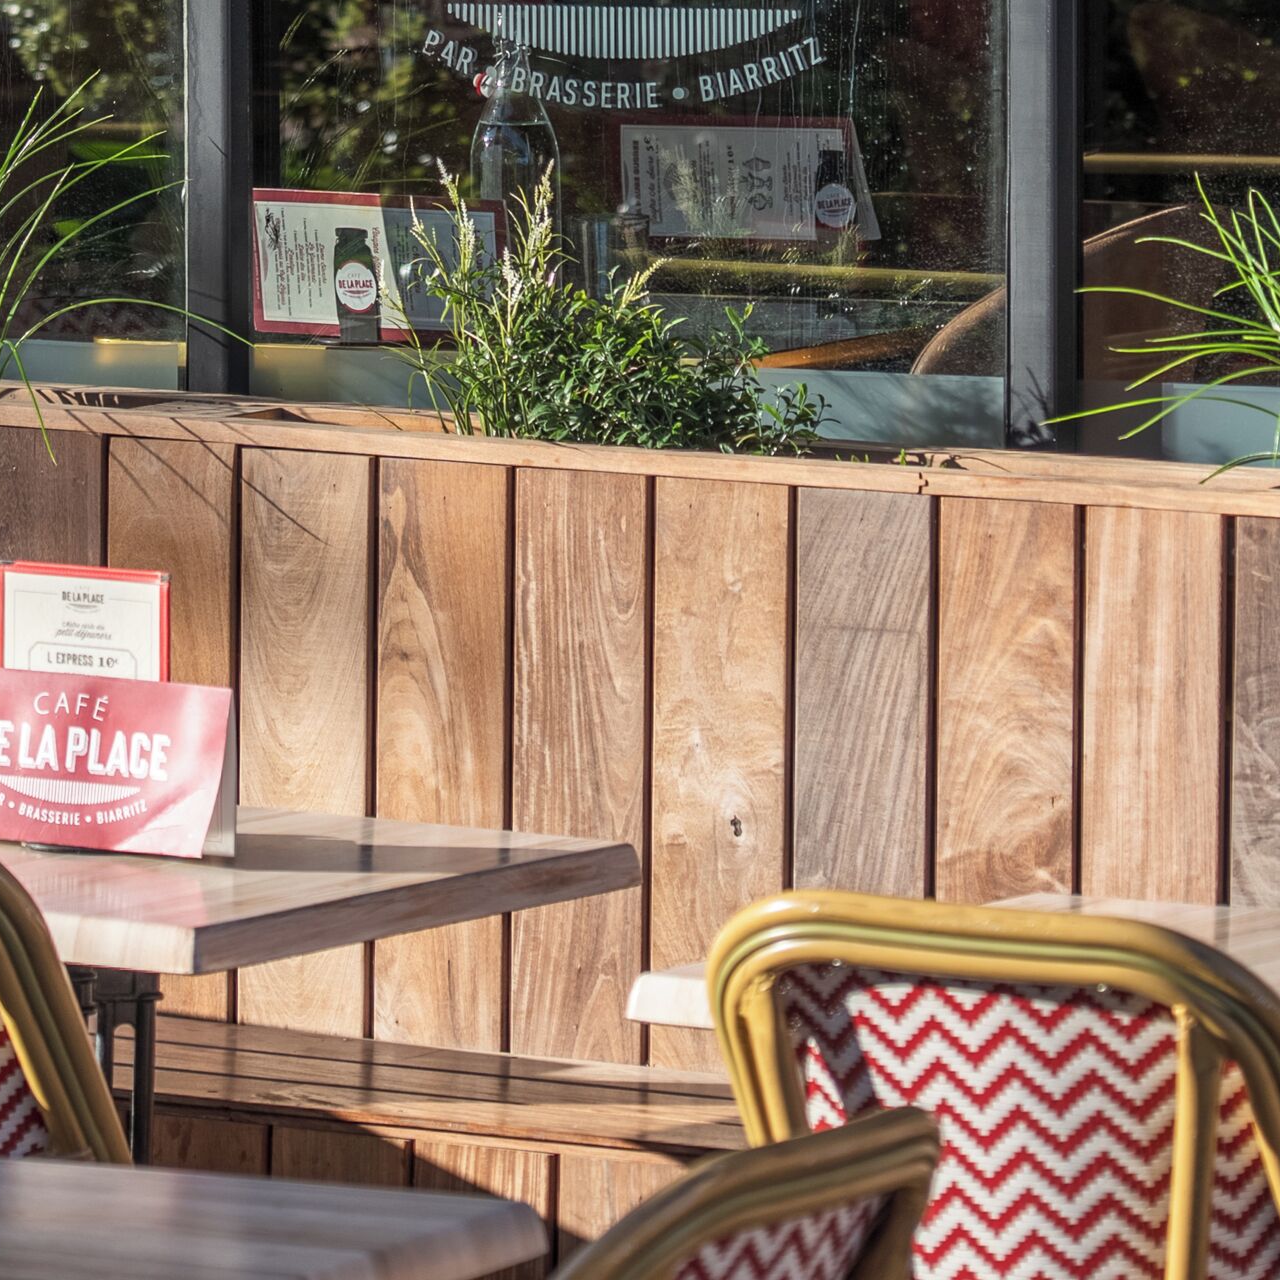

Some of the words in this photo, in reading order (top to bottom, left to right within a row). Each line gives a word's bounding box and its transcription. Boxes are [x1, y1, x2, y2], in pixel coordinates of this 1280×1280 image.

[421, 30, 476, 75] BAR
[510, 59, 662, 110] BRASSERIE
[698, 36, 825, 103] BIARRITZ
[354, 279, 373, 288] PLACE
[82, 593, 105, 604] PLACE
[56, 651, 94, 667] EXPRESS
[33, 691, 110, 721] CAFÉ
[18, 722, 60, 771] LA
[65, 725, 171, 782] PLACE
[18, 801, 80, 826] BRASSERIE
[96, 798, 148, 825] BIARRITZ
